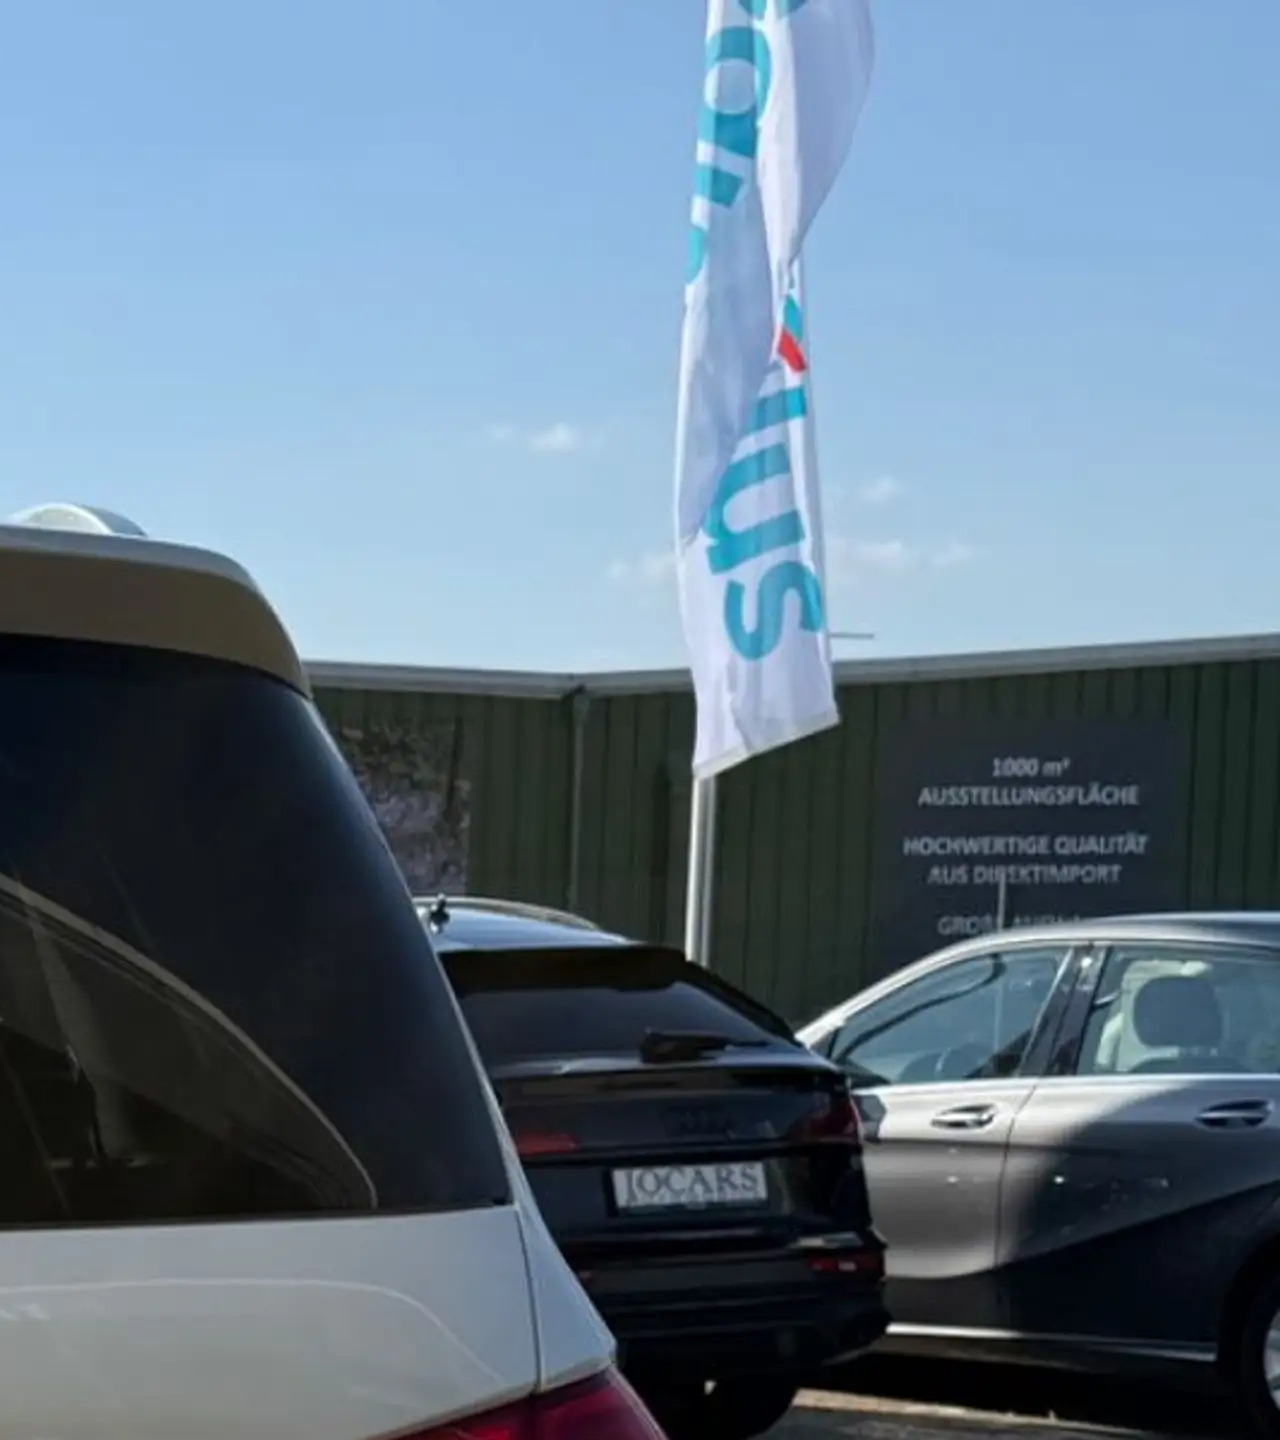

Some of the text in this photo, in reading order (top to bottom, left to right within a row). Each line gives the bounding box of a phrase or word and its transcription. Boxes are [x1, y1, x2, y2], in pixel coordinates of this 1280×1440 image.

[992, 757, 1039, 777] 1000
[917, 781, 1141, 807] AUSSTELLUNGSFLÄCHE
[903, 831, 1150, 857] HOCHWERTIGE QUALITÄT
[927, 865, 969, 884] AUS
[625, 1162, 759, 1203] JOCARS
